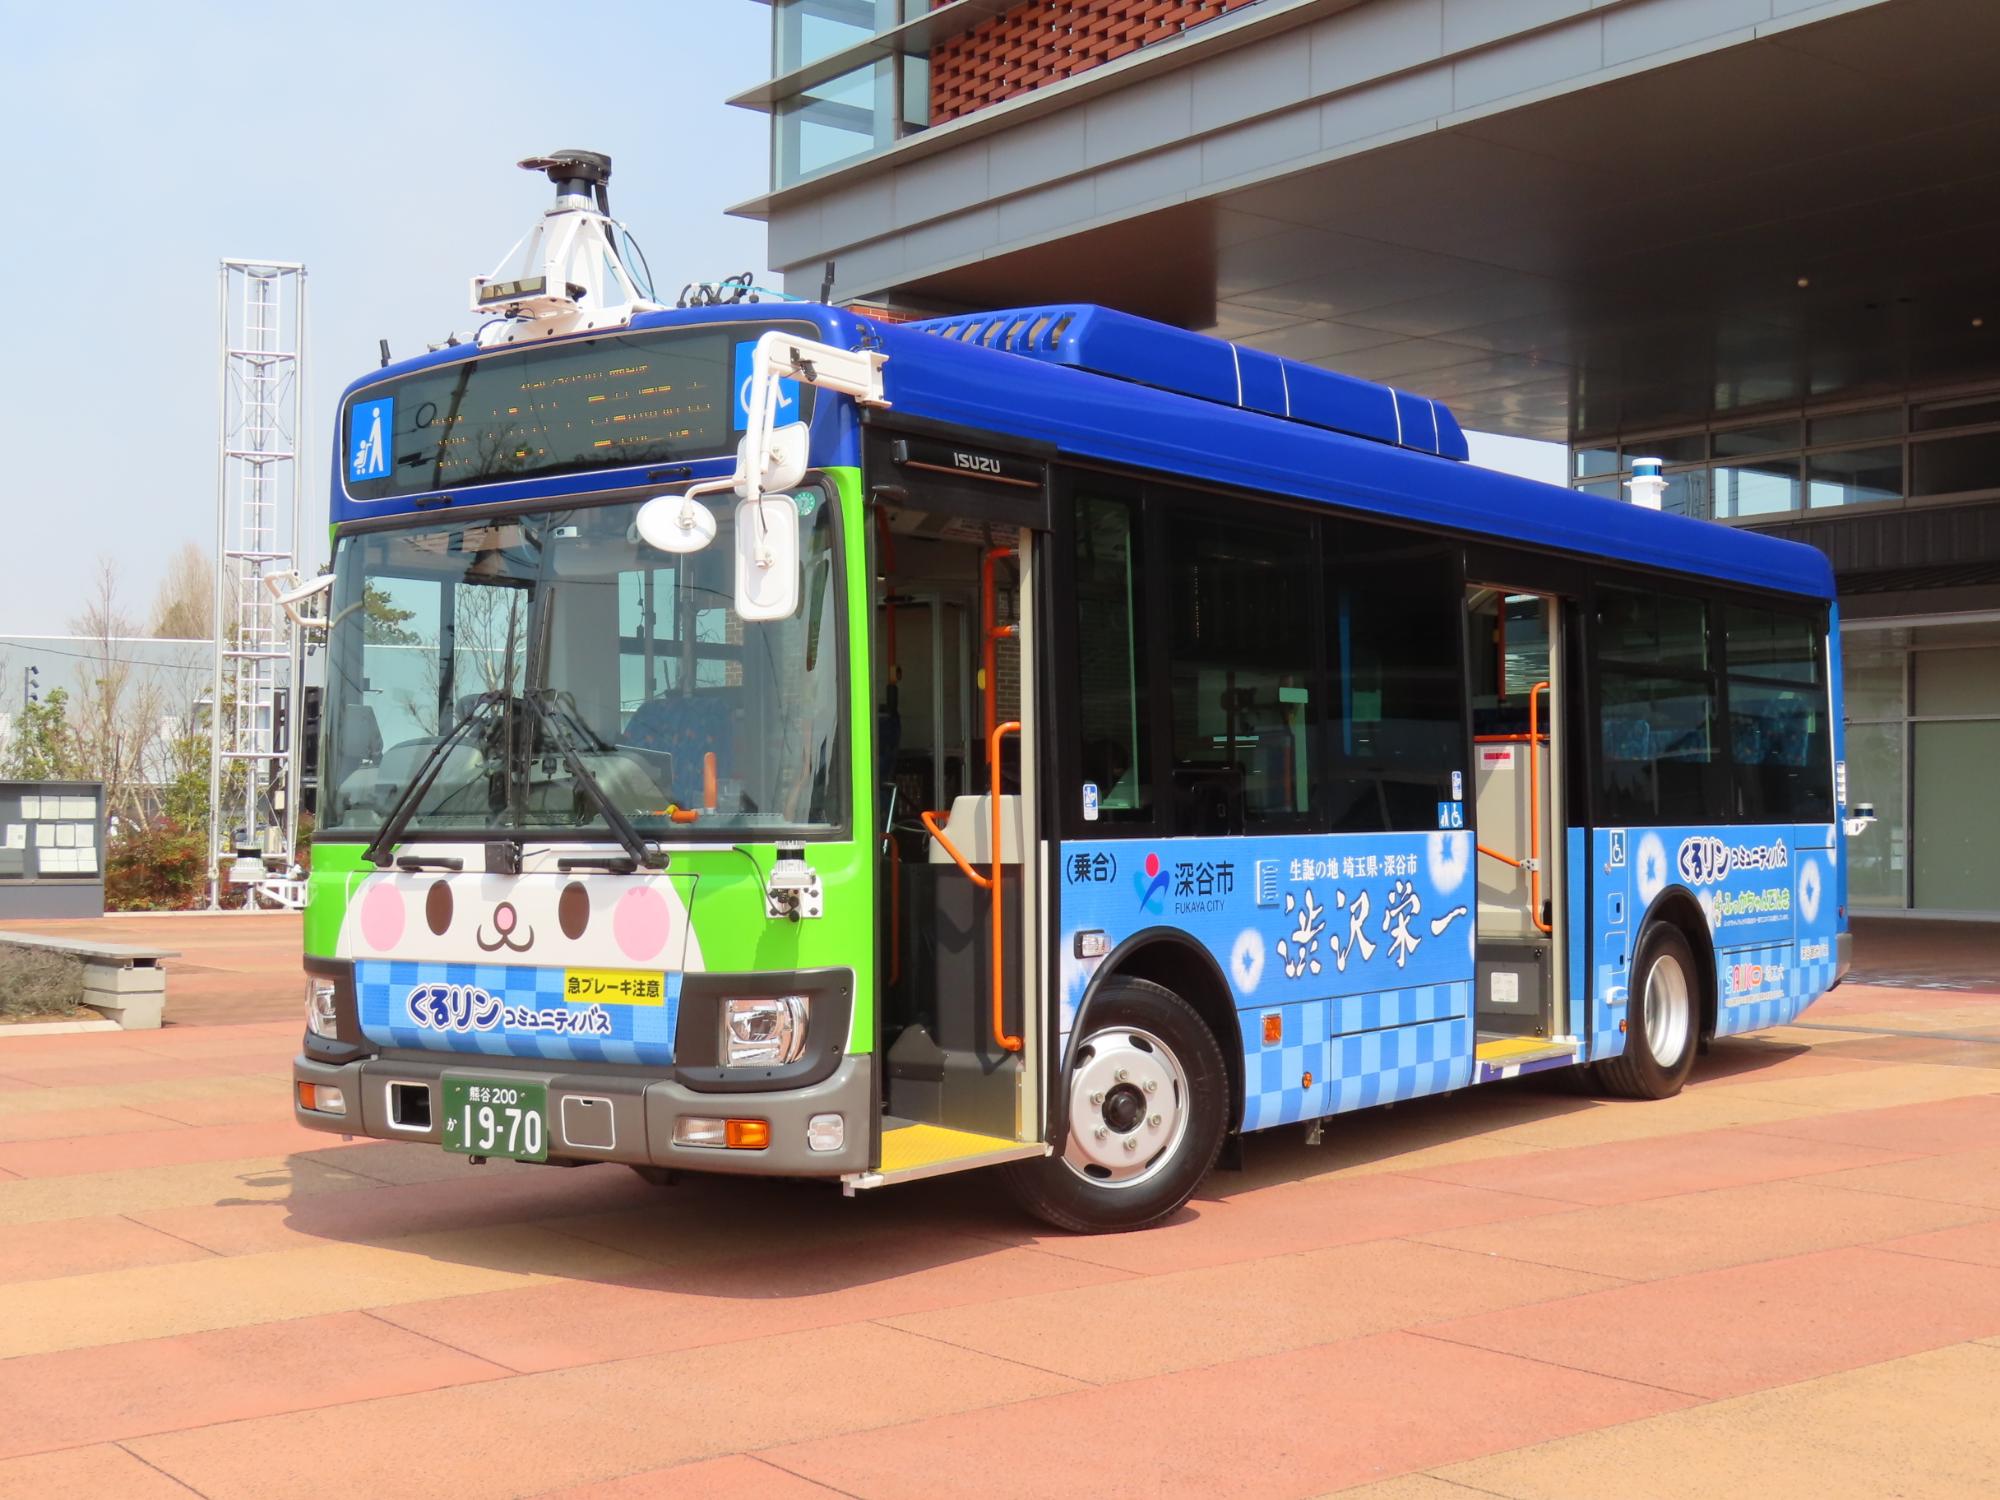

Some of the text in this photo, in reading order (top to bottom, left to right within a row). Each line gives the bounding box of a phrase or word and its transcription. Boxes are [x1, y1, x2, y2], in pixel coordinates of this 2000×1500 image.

[953, 452, 1001, 474] ISUZU
[1066, 852, 1117, 885] (乗合)
[1289, 858, 1339, 881] 生誕の地
[1678, 837, 1788, 885] くるリン コミュニティバス
[1174, 861, 1235, 897] 深谷市
[1175, 899, 1225, 914] FUKAYA CITY
[1277, 880, 1468, 978] 渋沢栄一
[567, 976, 661, 998] 急ブレーキ注意
[408, 985, 611, 1034] くるリン コミュニティバス
[446, 1104, 542, 1154] か 19-70
